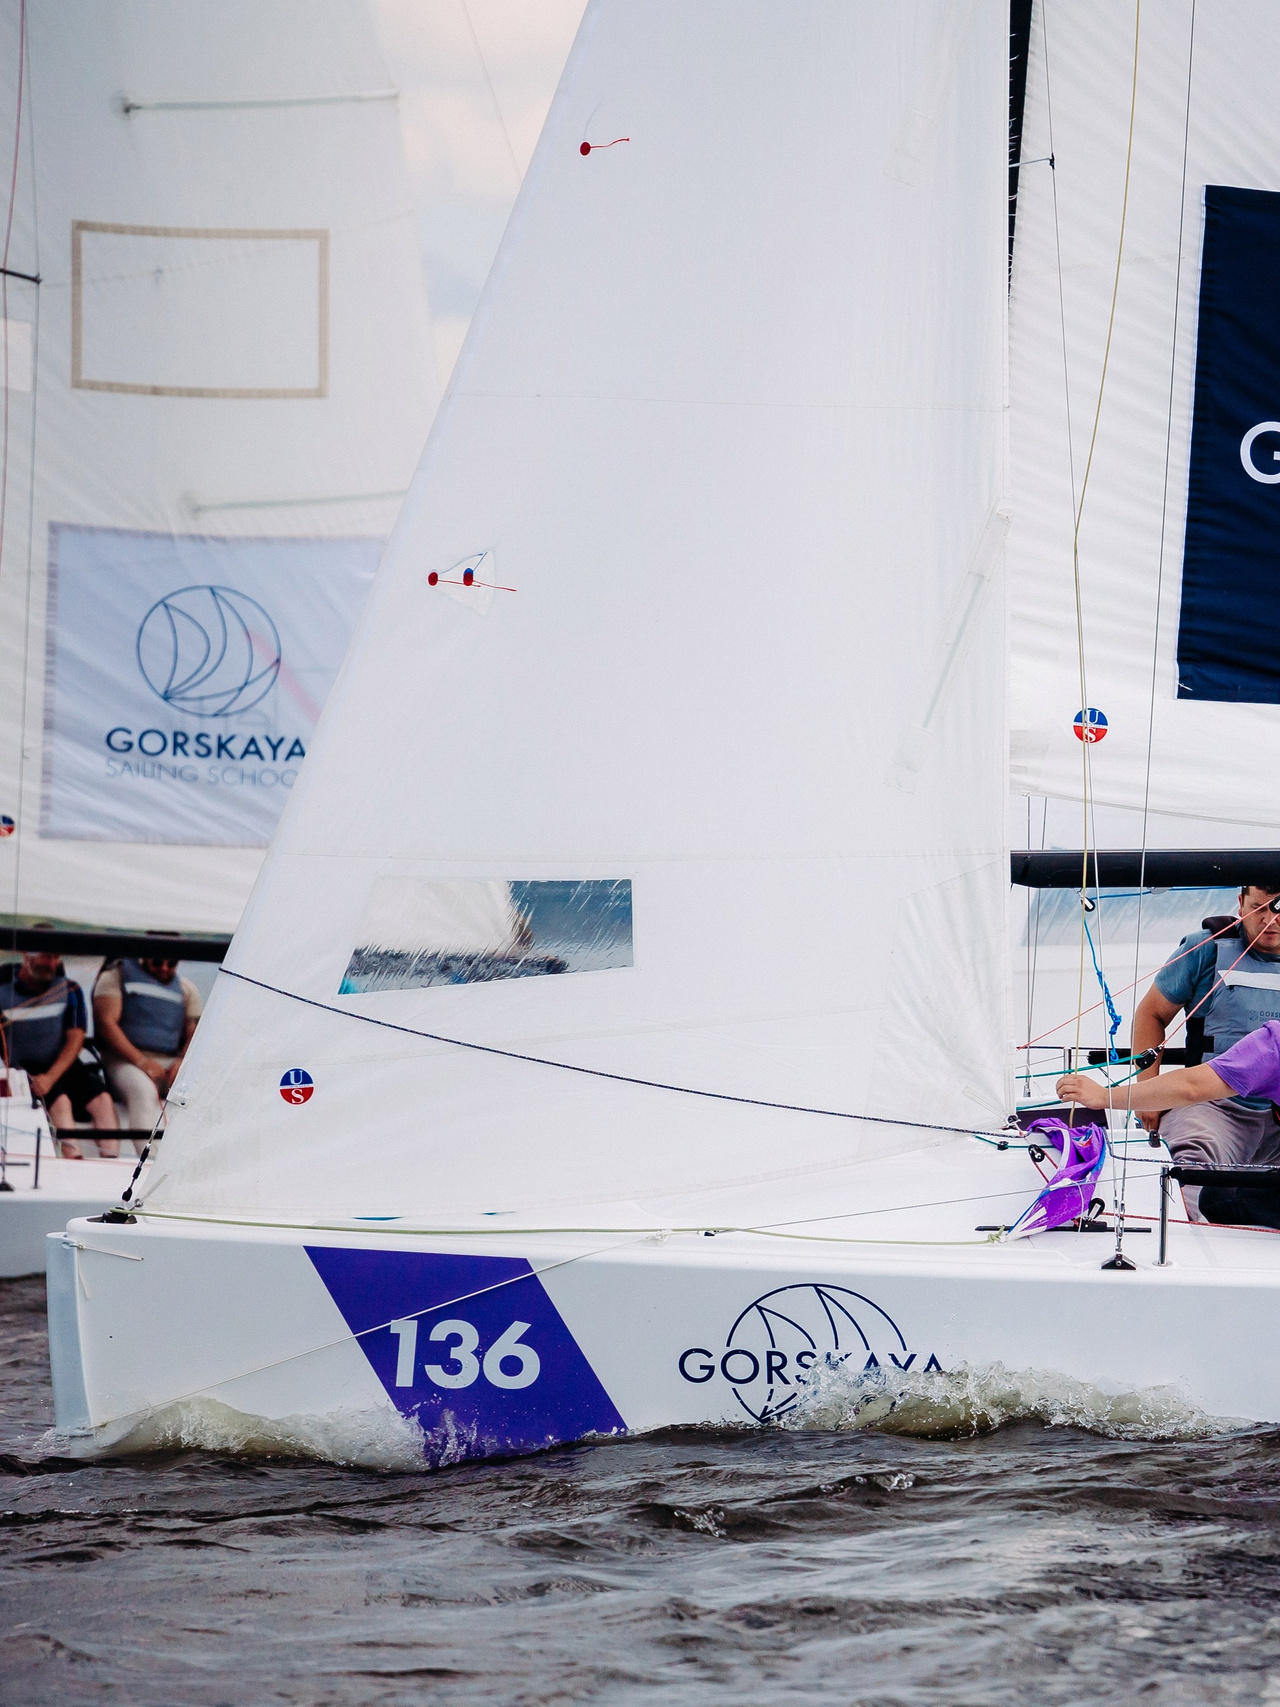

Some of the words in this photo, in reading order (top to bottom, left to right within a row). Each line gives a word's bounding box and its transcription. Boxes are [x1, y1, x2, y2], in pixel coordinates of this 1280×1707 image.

[105, 727, 307, 761] GORSKAYA
[105, 757, 199, 783] SAILING
[390, 1319, 541, 1390] 136
